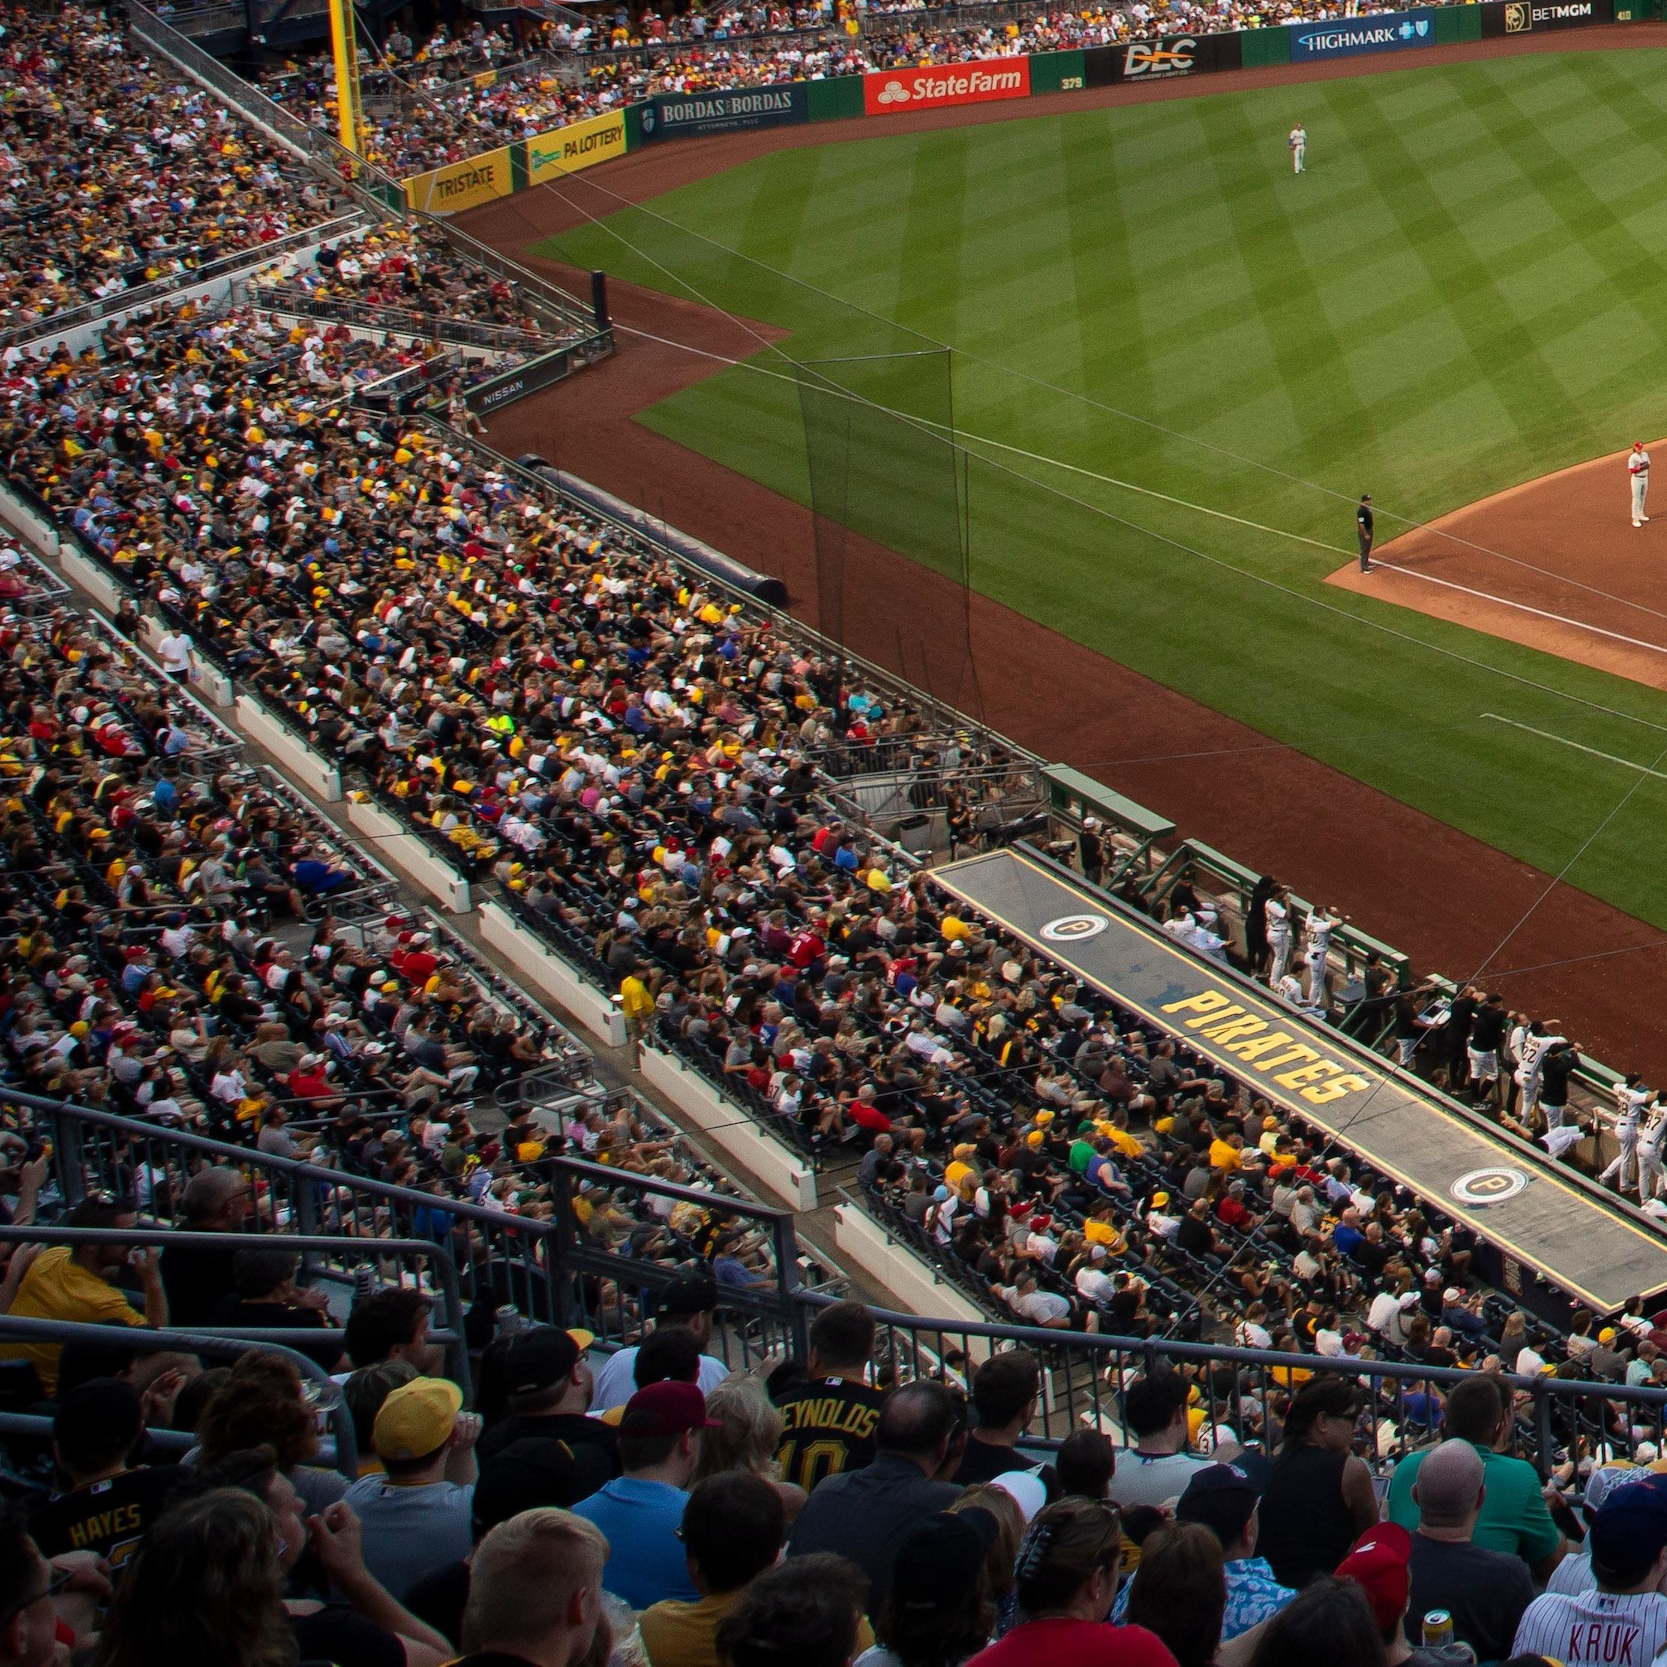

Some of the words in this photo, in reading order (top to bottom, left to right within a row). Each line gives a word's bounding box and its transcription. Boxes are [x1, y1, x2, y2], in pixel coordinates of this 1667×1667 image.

[1532, 3, 1591, 21] BETMGM
[1123, 40, 1197, 75] DLC
[1307, 27, 1394, 52] HIGHMARK
[1062, 78, 1083, 90] 379
[663, 100, 725, 123] BORDAS
[731, 91, 792, 114] BORDAS
[563, 141, 579, 161] PA
[579, 124, 625, 156] LOTTERY
[436, 164, 495, 200] TRISTATE
[1160, 989, 1372, 1105] PIRATES
[781, 1398, 880, 1438] EYNOLDS
[70, 1503, 141, 1548] HAYES
[1569, 1623, 1640, 1666] KRUK
